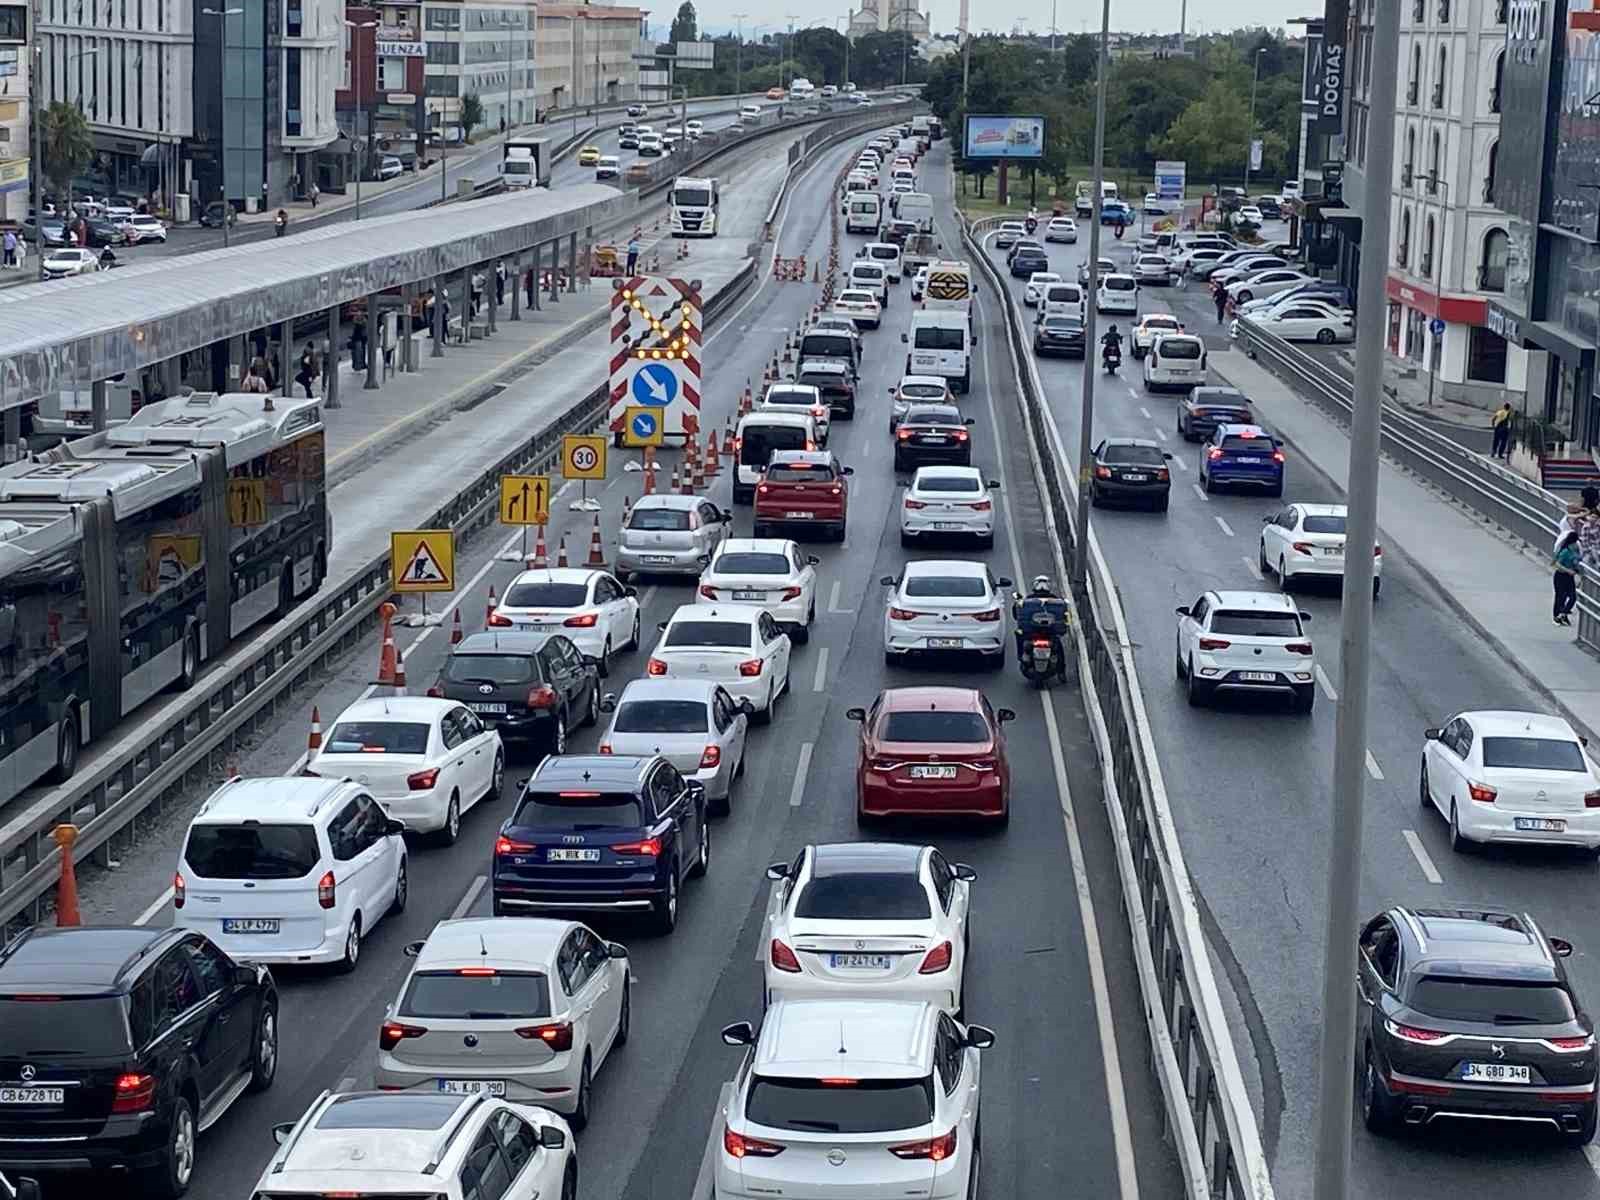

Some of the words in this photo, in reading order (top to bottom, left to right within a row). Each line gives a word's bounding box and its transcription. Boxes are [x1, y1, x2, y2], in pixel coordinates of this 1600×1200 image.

[576, 451, 594, 465] 30
[1472, 1064, 1482, 1076] 34
[1509, 1067, 1527, 1079] 348
[447, 1082, 457, 1093] 34
[18, 1090, 46, 1101] 6728
[48, 1090, 62, 1101] TC
